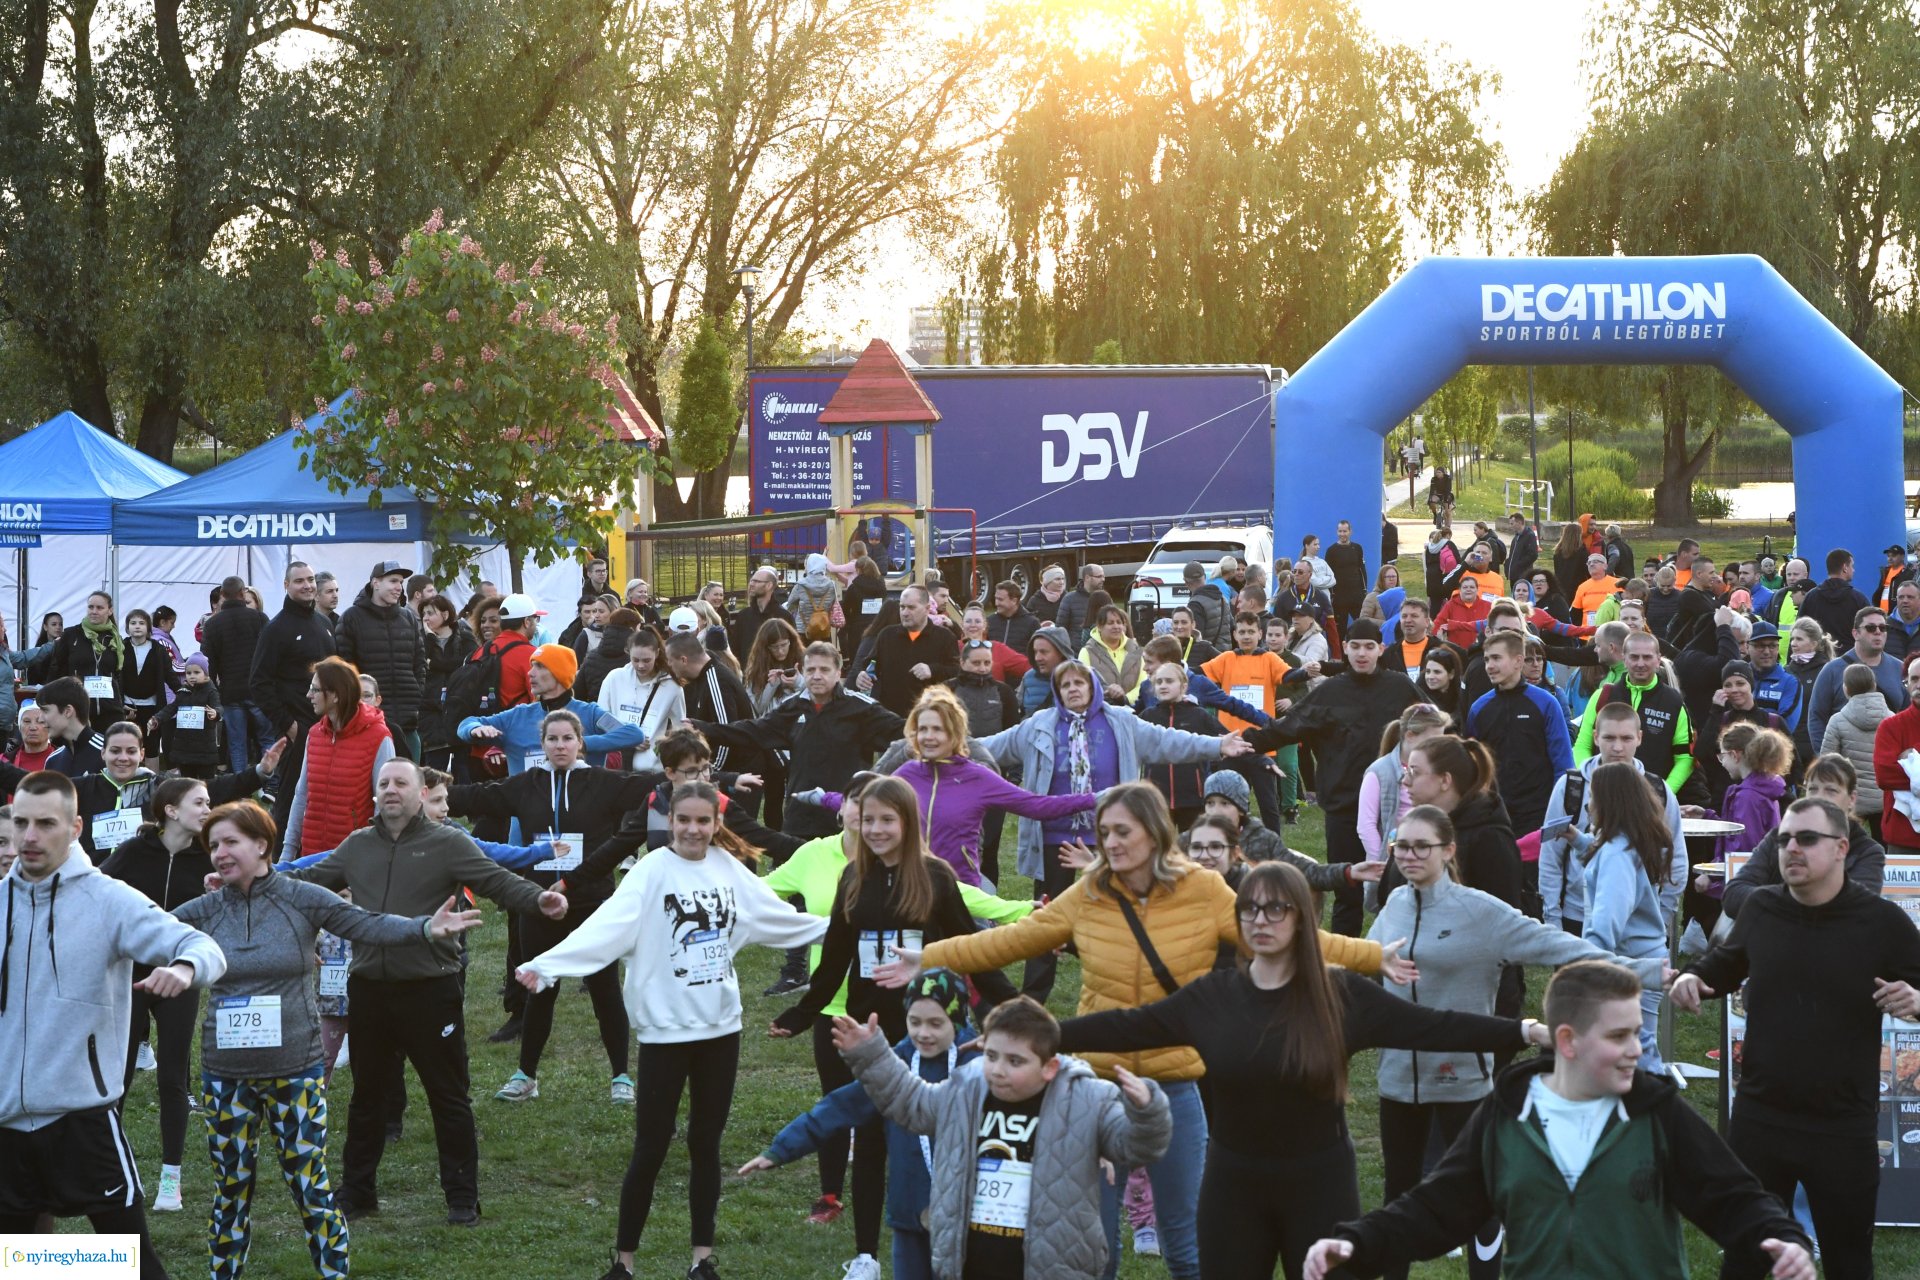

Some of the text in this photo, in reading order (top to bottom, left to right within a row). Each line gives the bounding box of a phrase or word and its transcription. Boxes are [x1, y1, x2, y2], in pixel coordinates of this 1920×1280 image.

[1481, 282, 1726, 322] DECATHLON
[1480, 322, 1726, 341] SPORTBÓL A LEGTÖBBET
[768, 429, 812, 441] NEMZETKÖZI
[1042, 411, 1149, 483] DSV
[771, 461, 788, 469] Tel.:
[771, 472, 788, 480] Tel.:
[197, 512, 336, 539] DECATHLON
[1645, 708, 1671, 720] UNCLE
[1646, 717, 1665, 728] SAM
[106, 821, 127, 832] 1771
[228, 1012, 262, 1028] 1278
[977, 1178, 1013, 1199] 287
